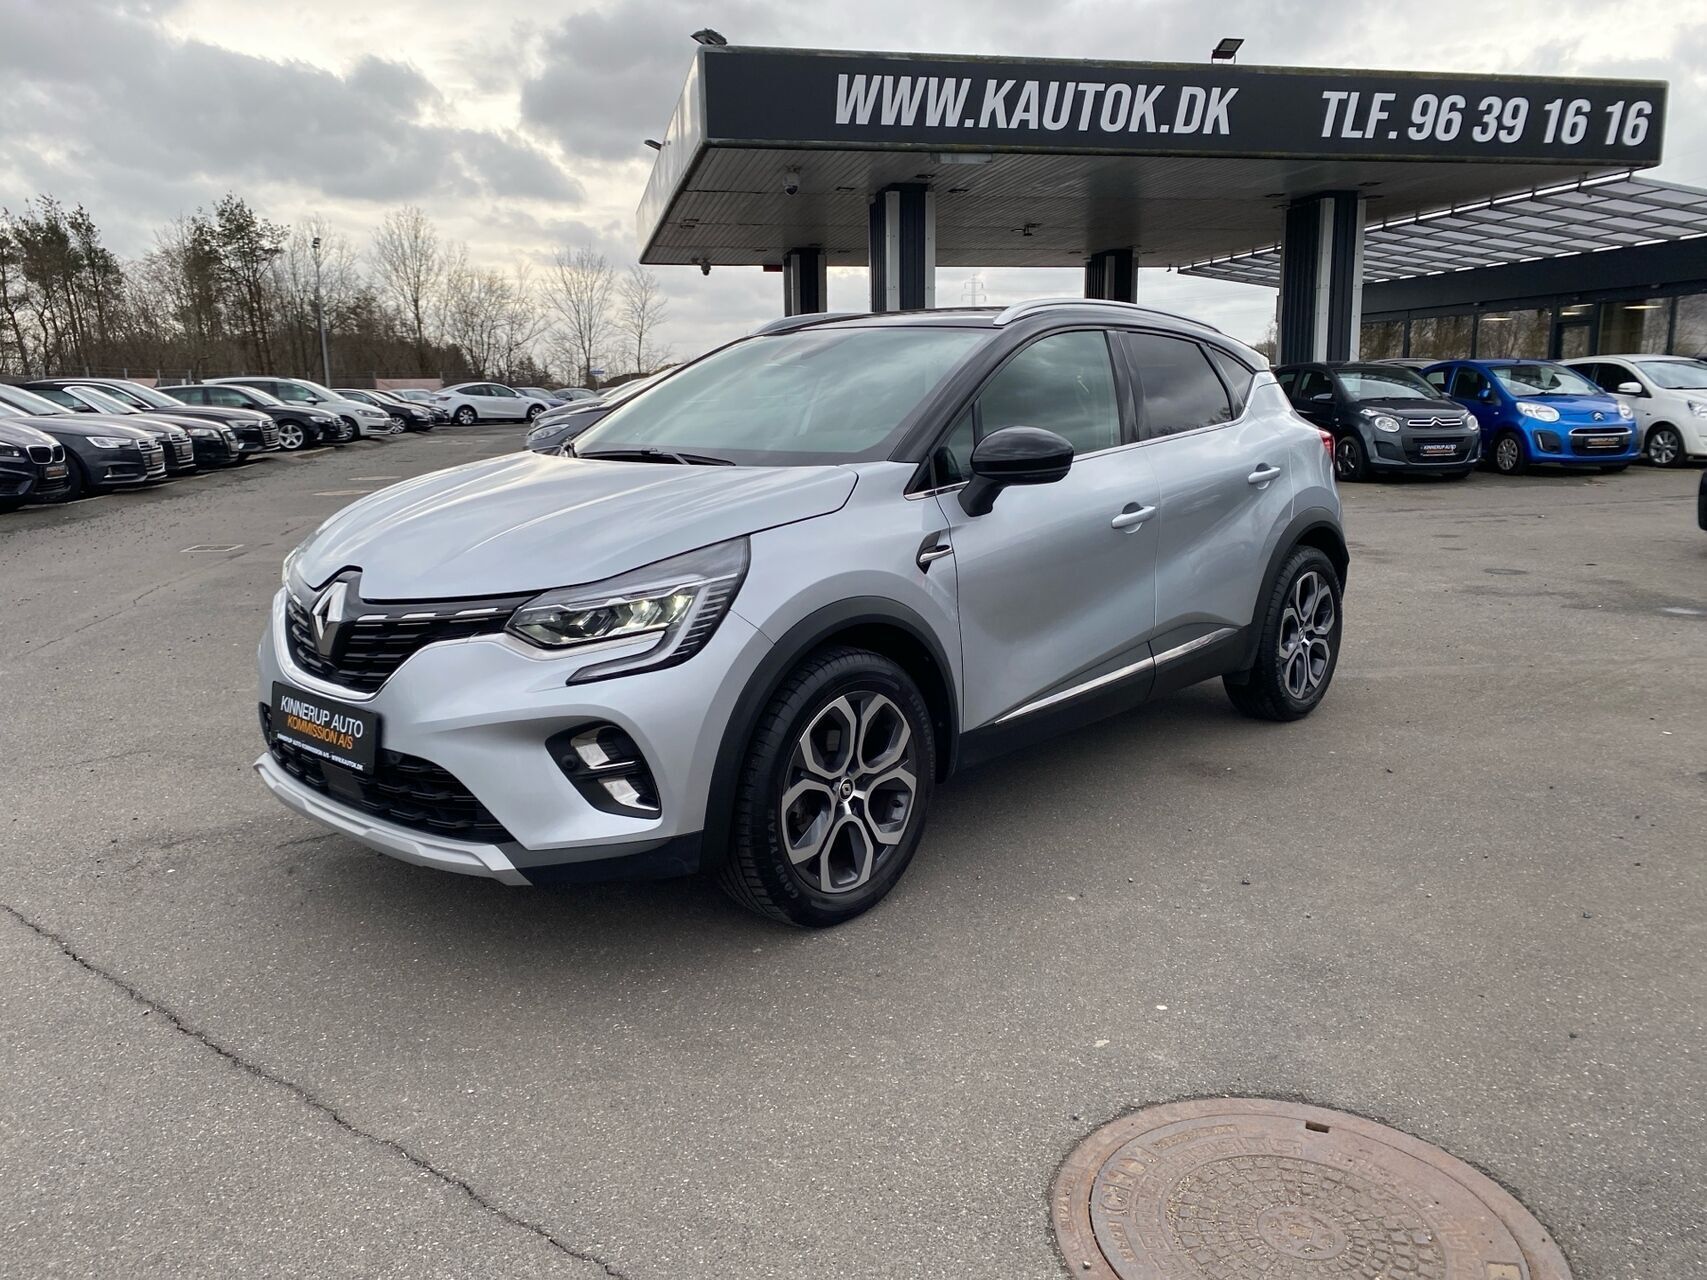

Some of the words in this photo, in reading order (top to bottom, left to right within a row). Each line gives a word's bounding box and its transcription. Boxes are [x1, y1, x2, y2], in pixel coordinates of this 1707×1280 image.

[835, 73, 1239, 135] WWW.KAUTOK.DK
[1321, 90, 1398, 139] TLF.
[1407, 93, 1467, 142] 96
[1472, 95, 1530, 143] 39
[1543, 98, 1591, 145] 16
[1604, 100, 1653, 147] 16
[280, 695, 330, 726] KINNERUP
[330, 713, 364, 738] AUTO
[287, 715, 337, 744] KOMMISSION
[336, 733, 354, 750] A/S
